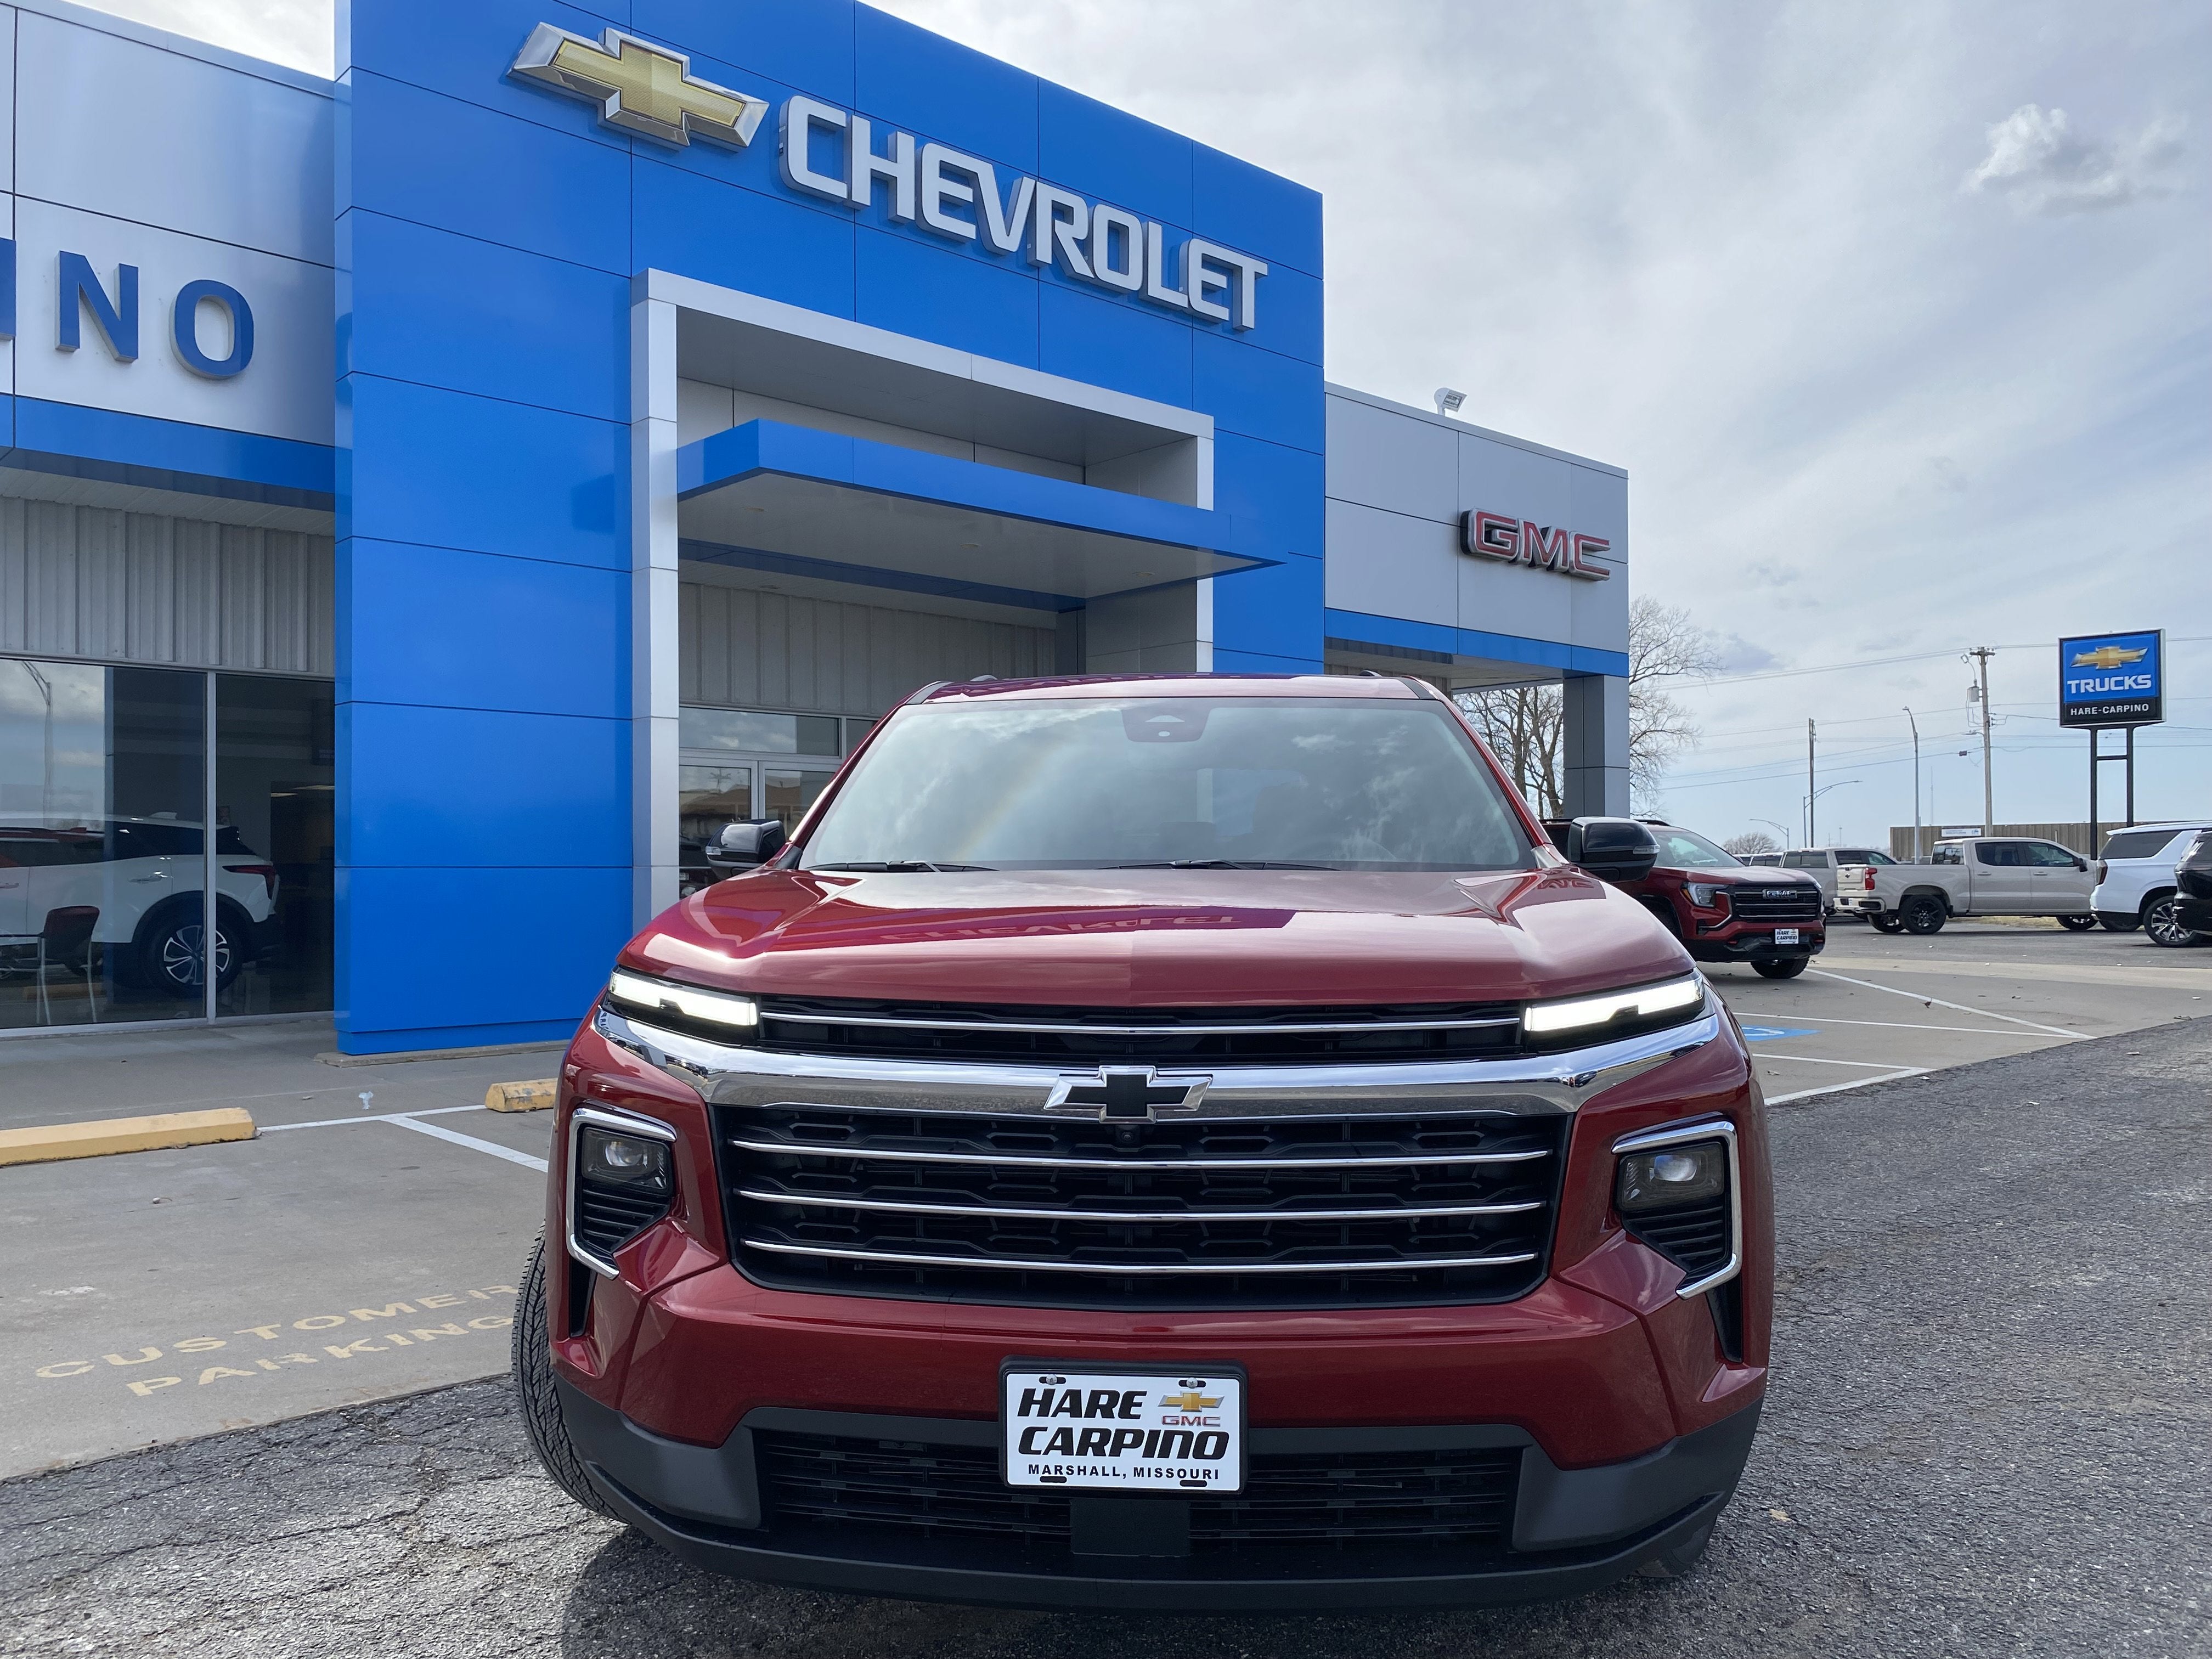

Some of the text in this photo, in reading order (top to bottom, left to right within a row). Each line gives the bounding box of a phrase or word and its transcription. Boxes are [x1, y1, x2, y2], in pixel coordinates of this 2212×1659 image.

[778, 94, 1268, 331] CHEVROLET
[1460, 507, 1611, 580] GMC
[2067, 674, 2152, 694] TRUCKS
[2070, 703, 2149, 716] HARE-CARPINO
[1767, 890, 1797, 898] GMC
[36, 1284, 518, 1379] CUSTOMER
[126, 1315, 514, 1397] PARKING
[1017, 1387, 1148, 1420] HARE
[1160, 1415, 1221, 1427] GMC
[1018, 1426, 1230, 1460] CARPINO
[1028, 1464, 1219, 1480] MARSHALL, MISSOURI
